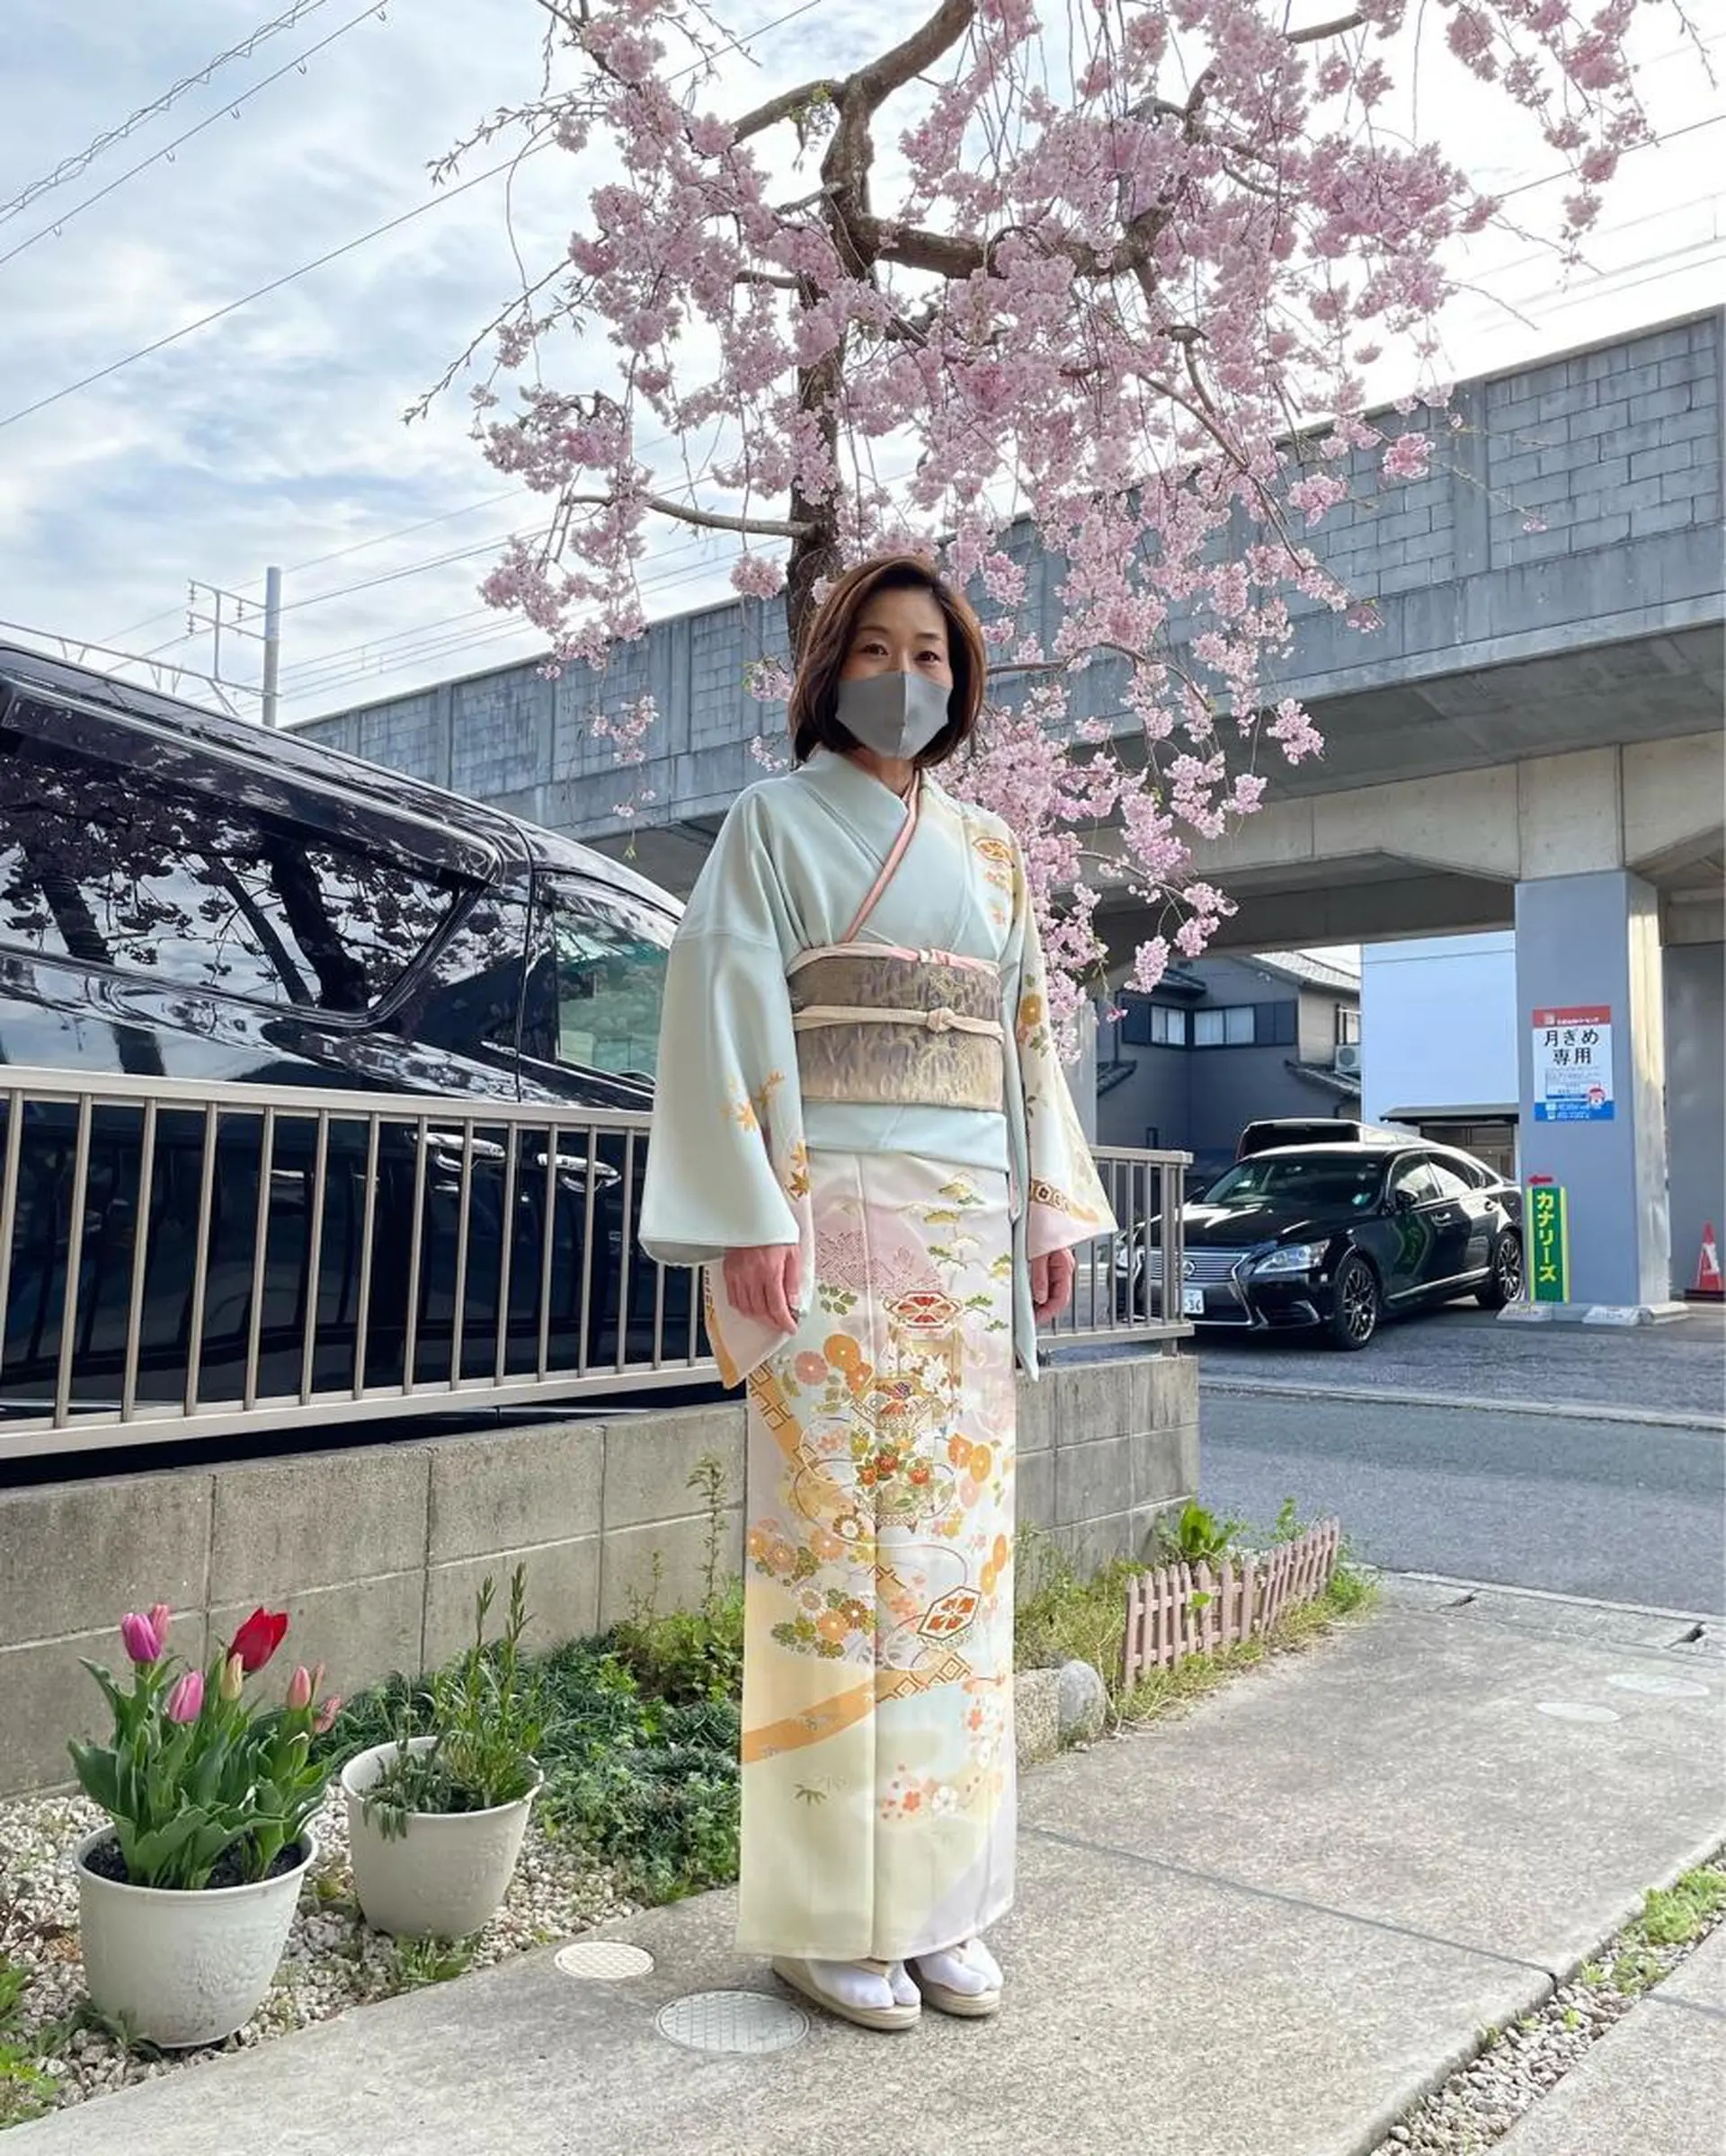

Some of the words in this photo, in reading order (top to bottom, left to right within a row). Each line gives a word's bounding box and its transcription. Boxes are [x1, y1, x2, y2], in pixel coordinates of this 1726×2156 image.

[1544, 1028, 1599, 1047] 月ぎめ
[1553, 1047, 1591, 1066] 専用
